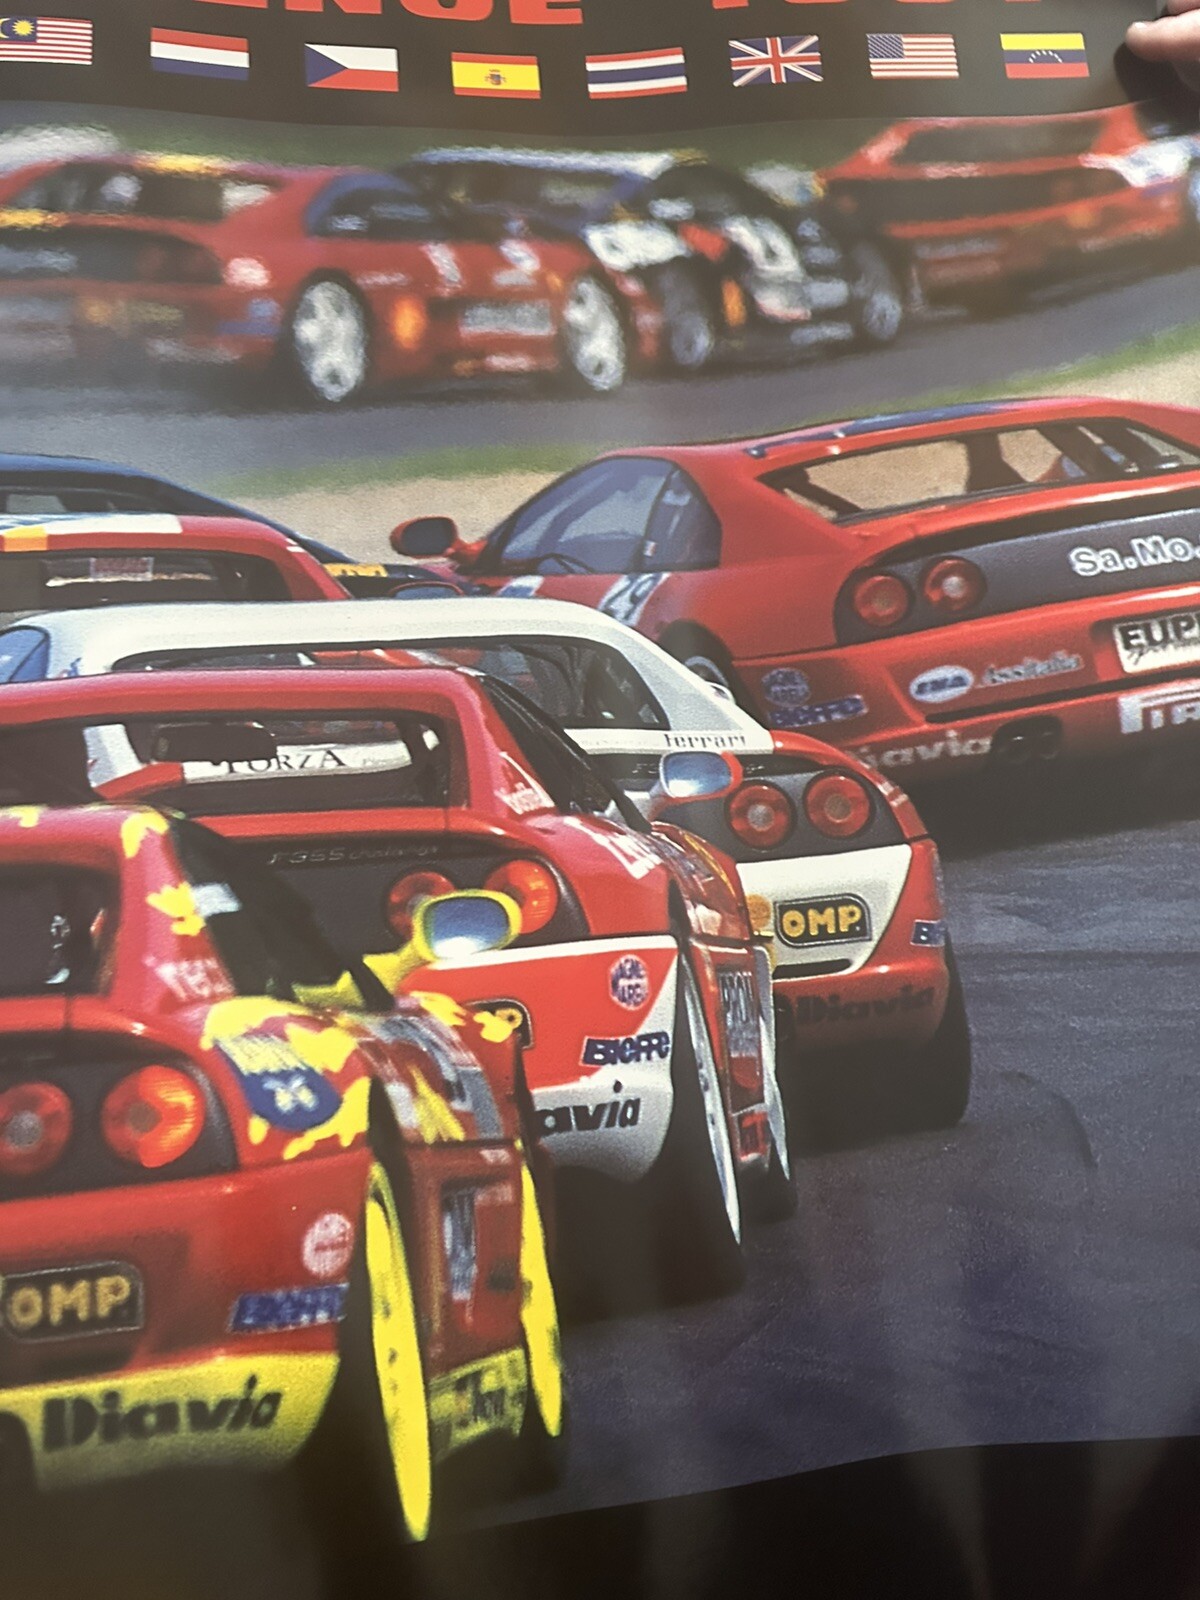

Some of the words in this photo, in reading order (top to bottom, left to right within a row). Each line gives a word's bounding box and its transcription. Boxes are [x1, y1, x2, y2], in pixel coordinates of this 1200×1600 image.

[781, 904, 862, 938] OMP
[6, 1274, 132, 1330] OMP
[43, 1374, 283, 1452] Diavia
